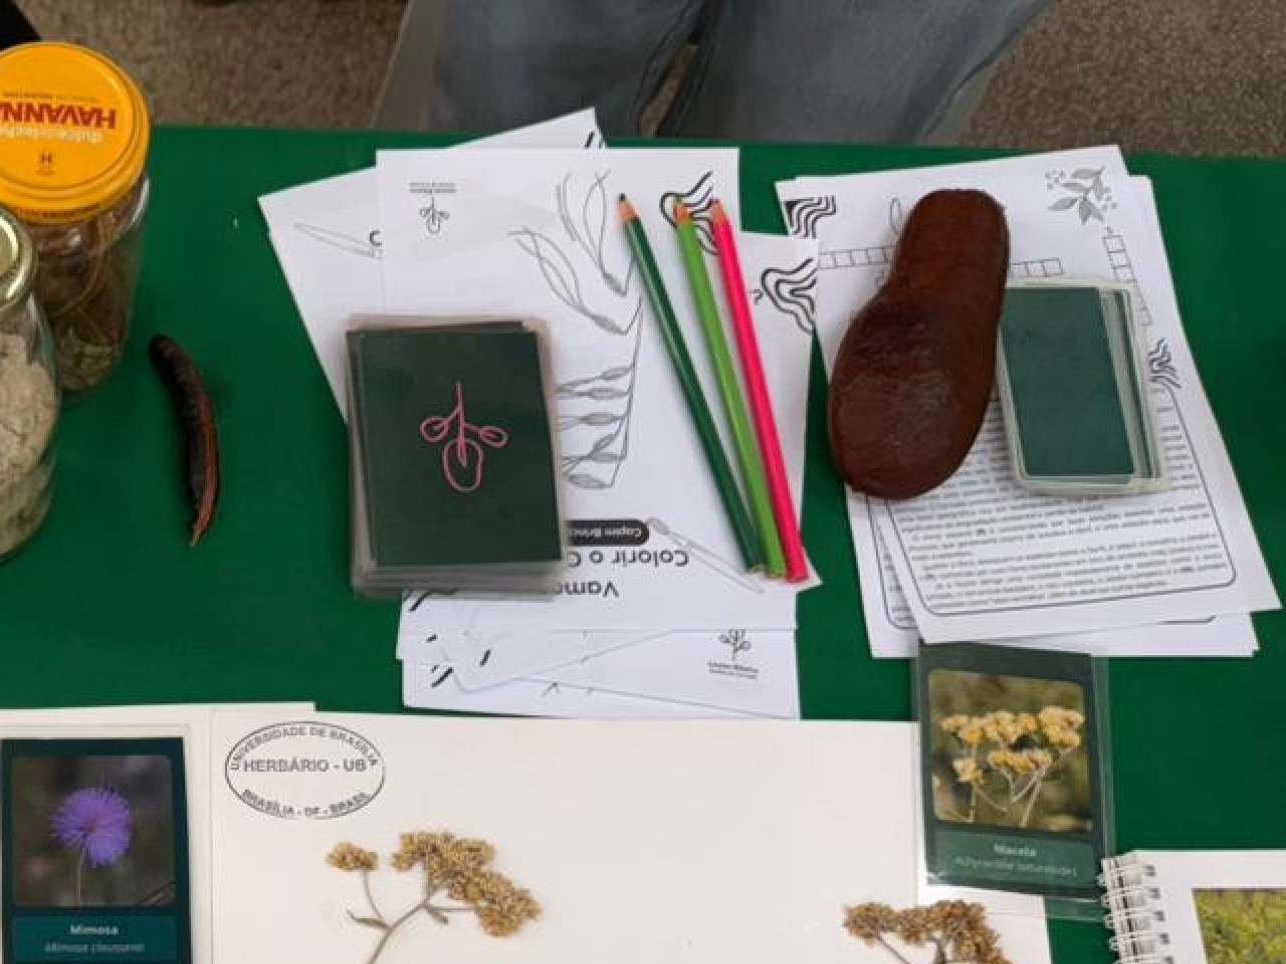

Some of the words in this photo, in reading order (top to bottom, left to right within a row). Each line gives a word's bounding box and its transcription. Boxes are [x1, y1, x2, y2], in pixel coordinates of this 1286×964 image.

[589, 550, 603, 564] o
[612, 550, 689, 568] Colorir
[244, 757, 329, 772] HERBÁRIO
[343, 759, 367, 772] UB
[69, 924, 119, 936] Mimosa
